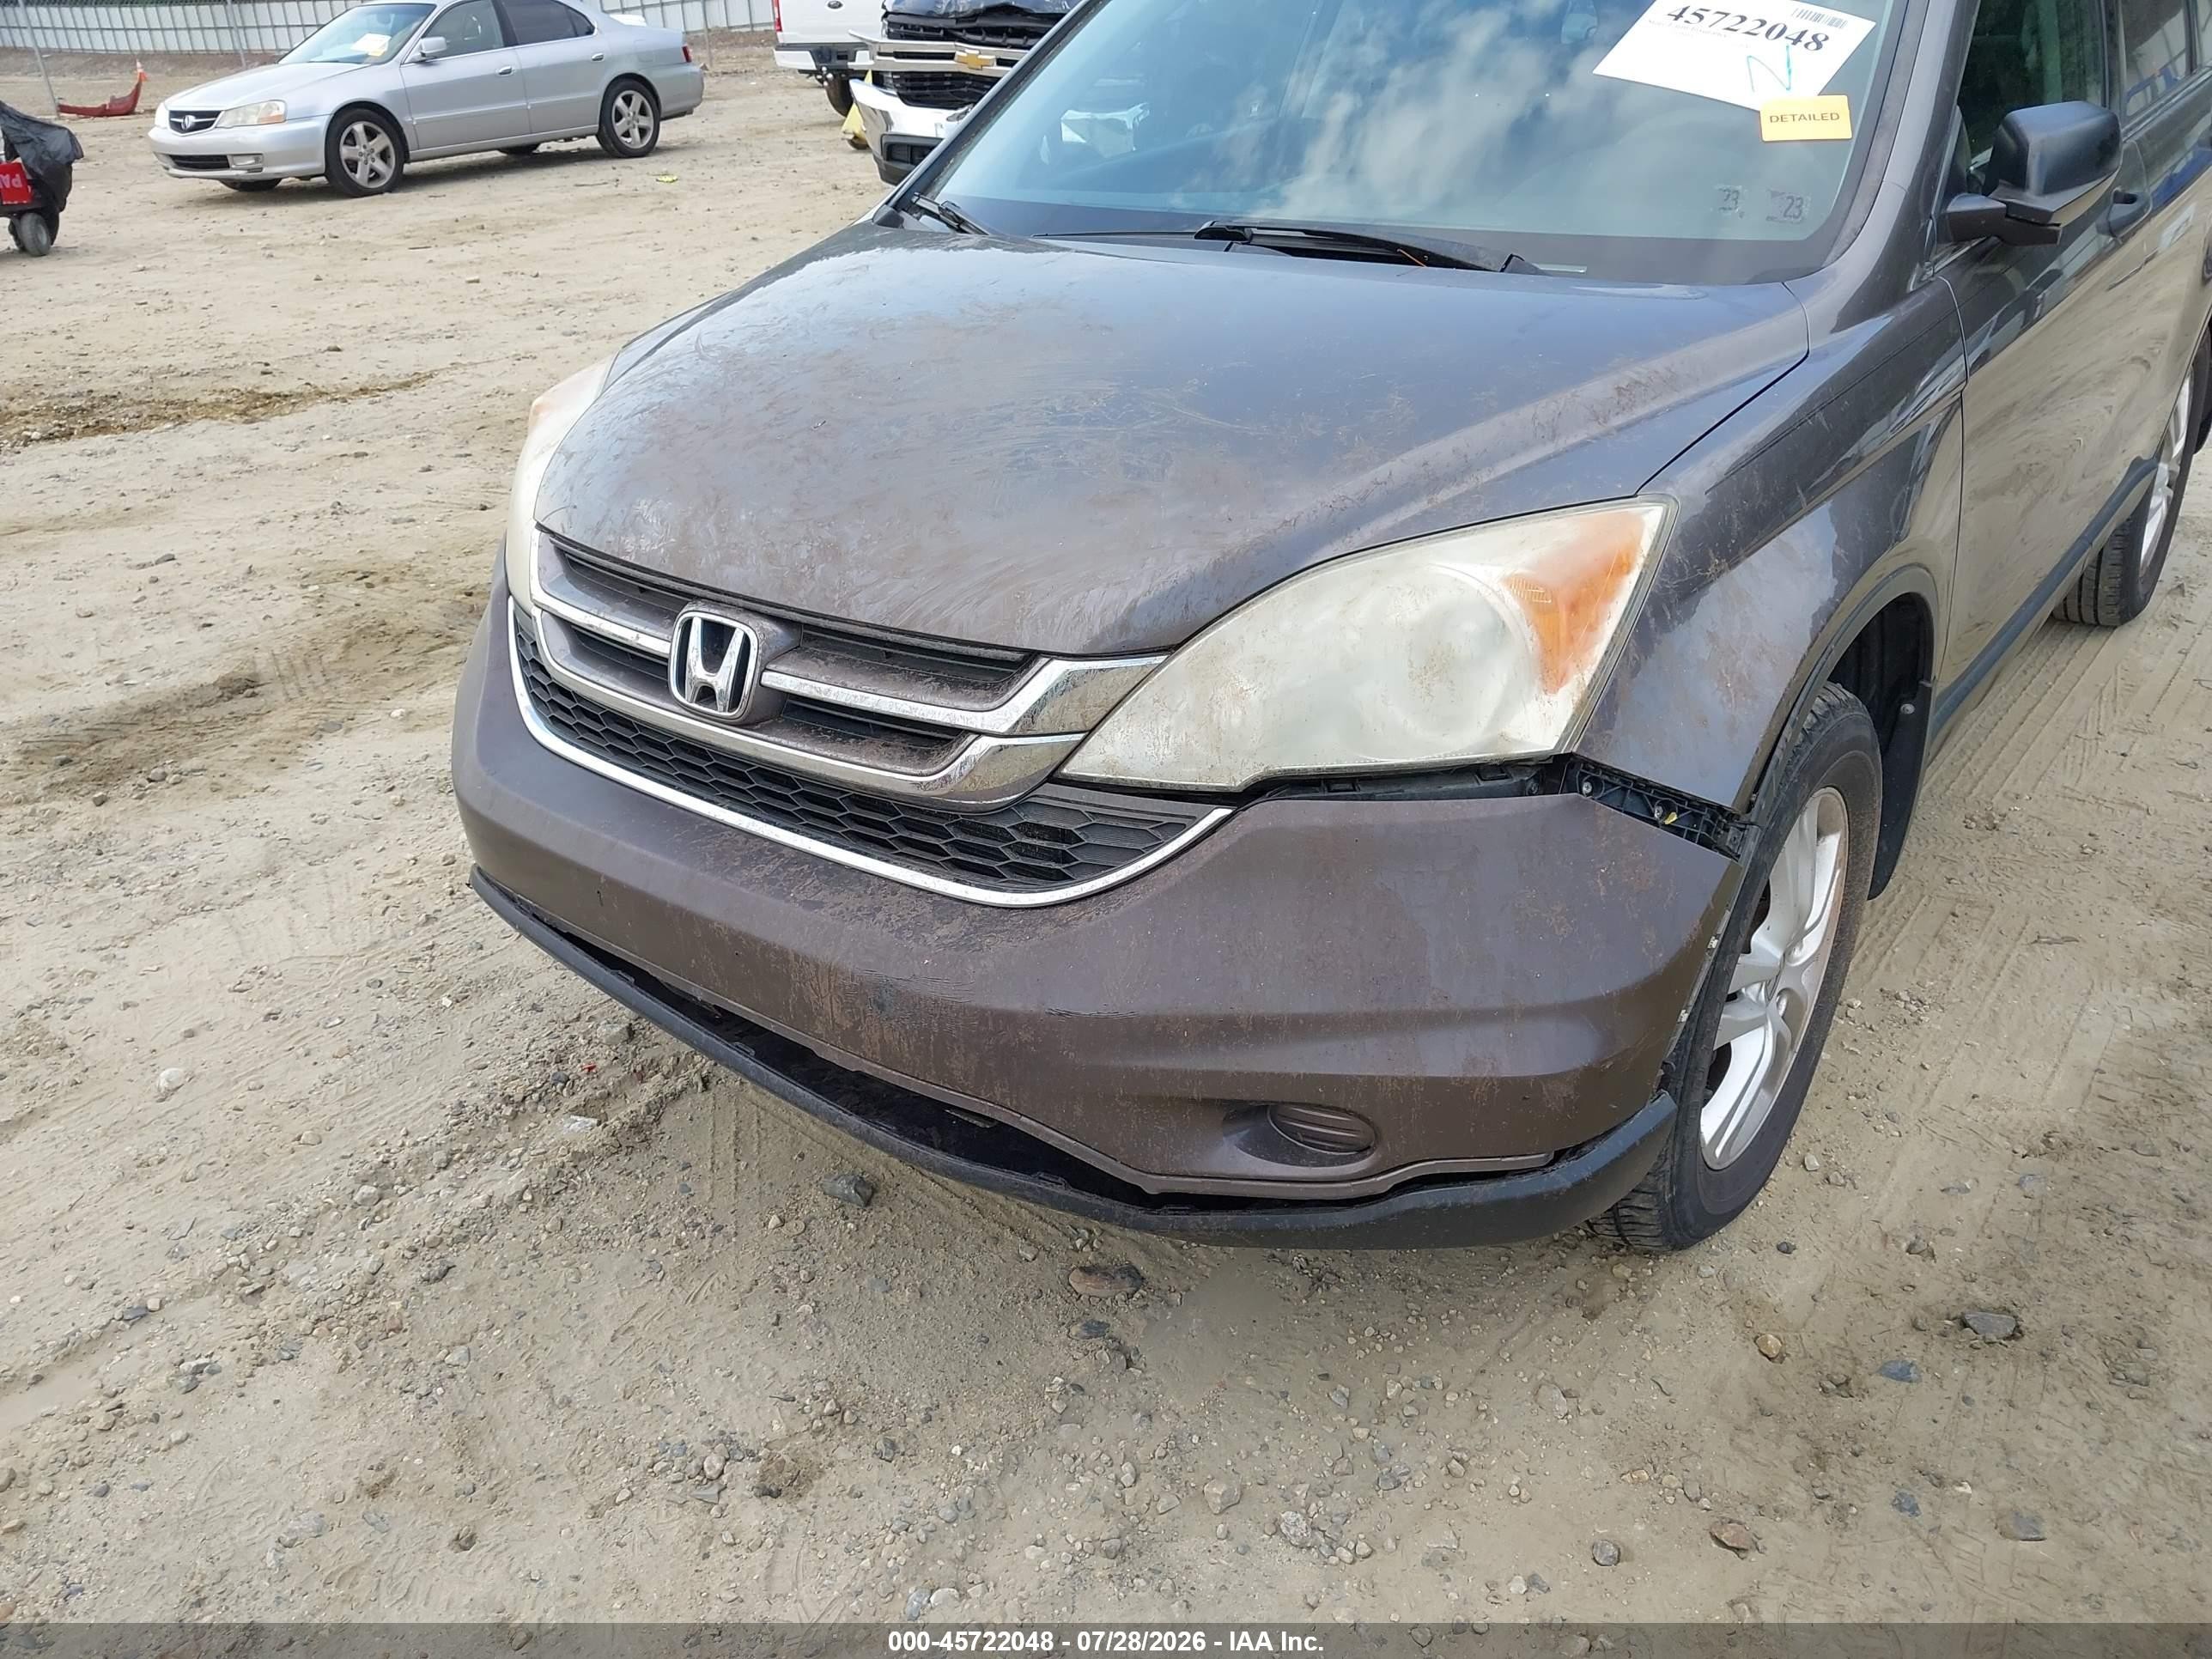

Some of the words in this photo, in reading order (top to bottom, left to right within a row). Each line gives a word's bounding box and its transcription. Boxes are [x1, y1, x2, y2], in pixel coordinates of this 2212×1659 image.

[1667, 5, 1830, 52] 45722048
[1769, 112, 1840, 124] DETAILED
[0, 173, 23, 188] PA
[1783, 195, 1804, 220] 23
